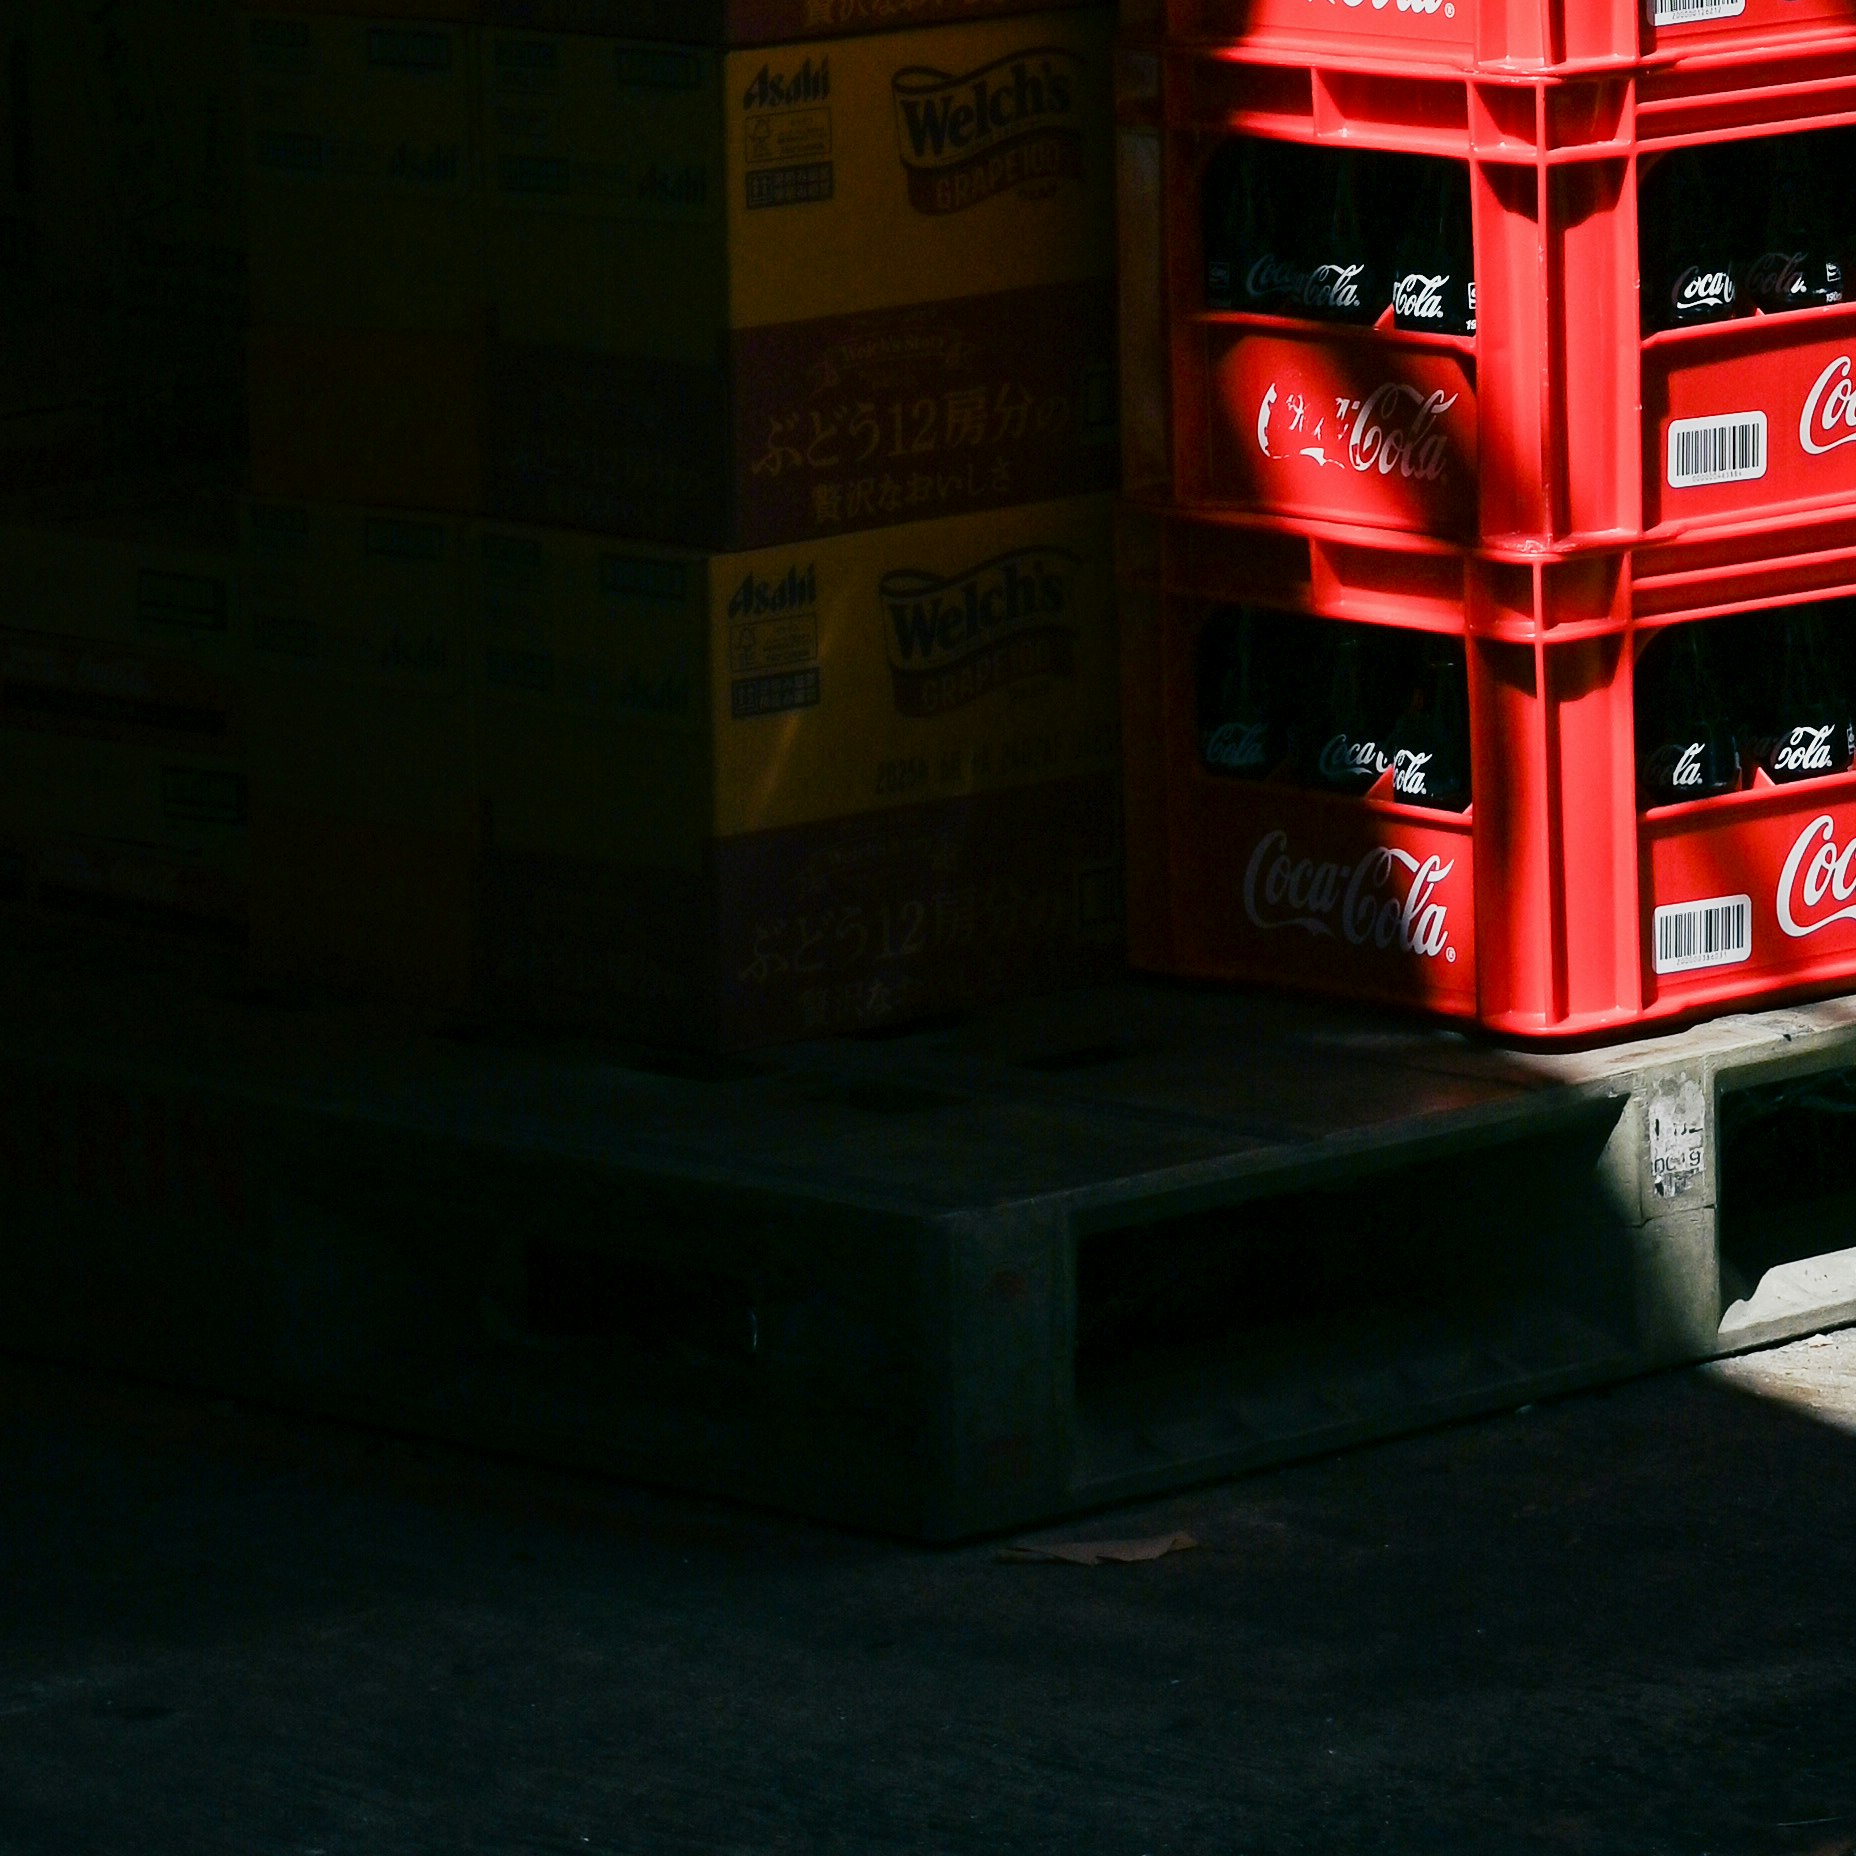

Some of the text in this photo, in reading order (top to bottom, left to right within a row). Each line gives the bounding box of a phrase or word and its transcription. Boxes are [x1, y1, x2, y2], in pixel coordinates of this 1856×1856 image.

[902, 64, 1072, 158] Welch's
[749, 382, 1070, 476] ぶどう12房分の
[892, 563, 1066, 661] Welch's
[1243, 829, 1455, 959] Coca-Cola
